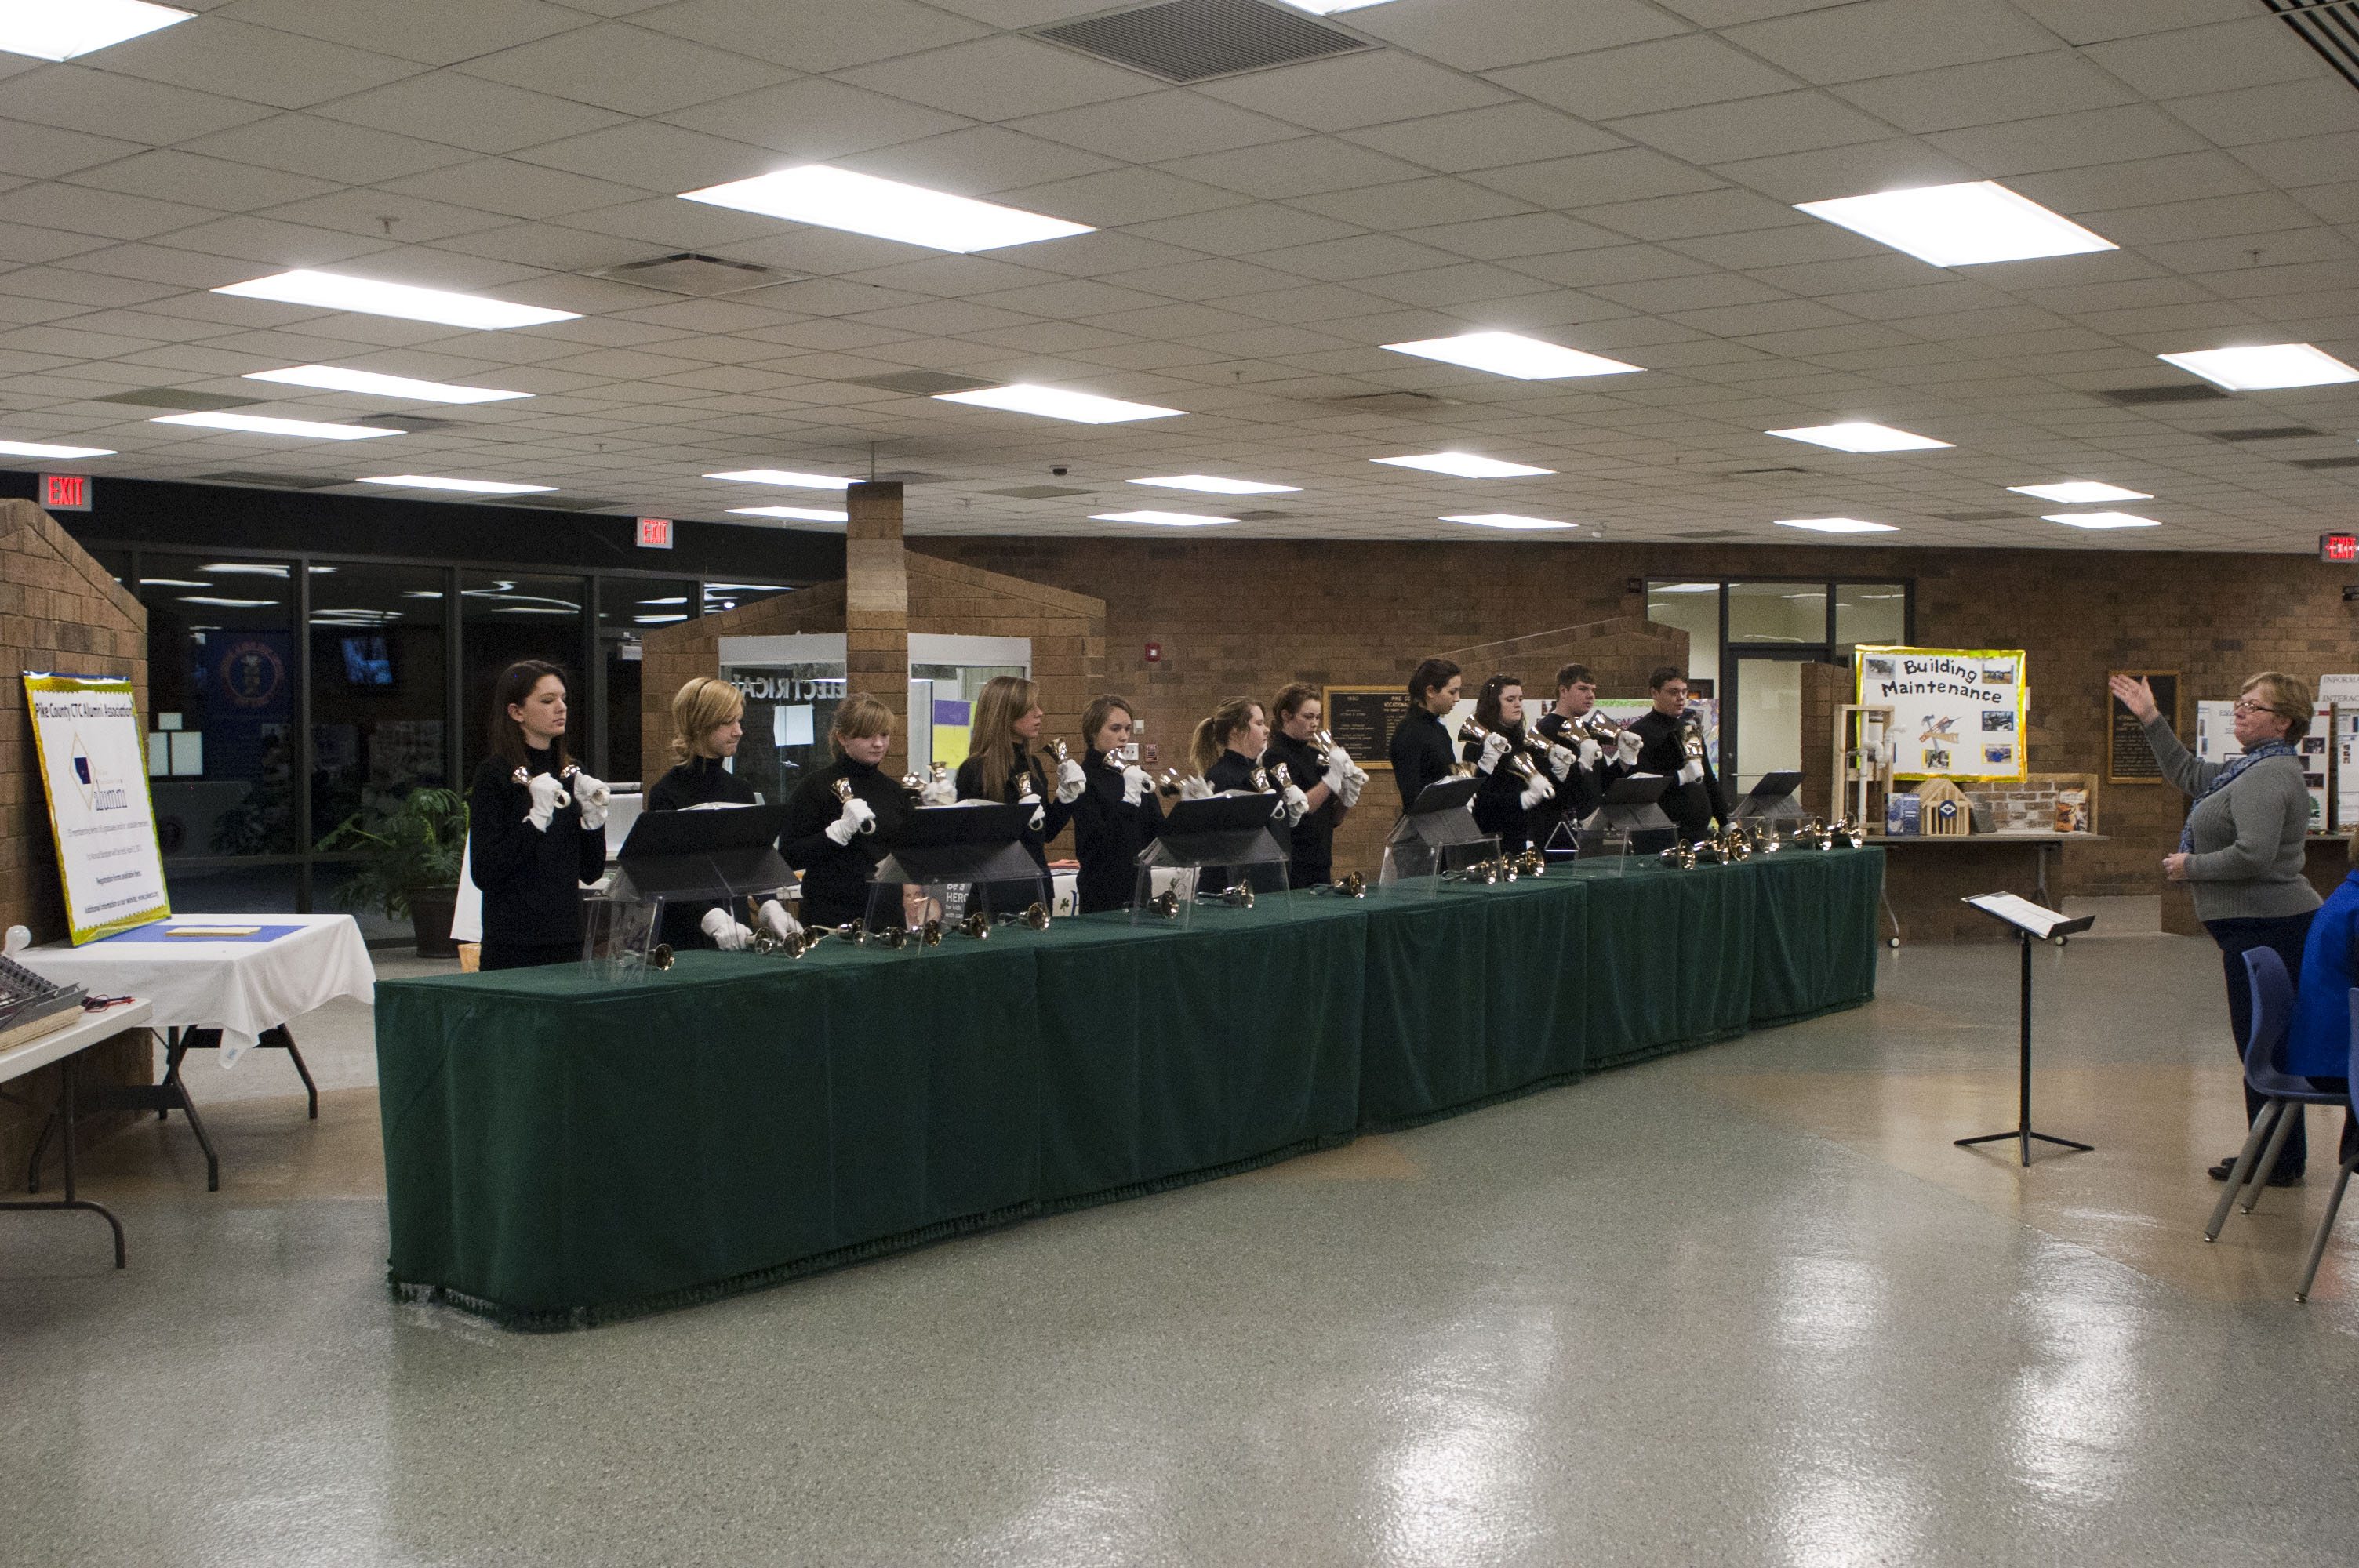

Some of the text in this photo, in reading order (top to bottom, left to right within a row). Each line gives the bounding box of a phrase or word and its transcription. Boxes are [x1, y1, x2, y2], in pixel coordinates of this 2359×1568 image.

[49, 476, 84, 506] EXIT
[644, 519, 668, 544] EXIT
[2329, 536, 2356, 558] EXIT
[1903, 658, 1978, 684] Building
[1881, 680, 2002, 703] Maintenance
[35, 702, 133, 721] Pike County CTC Alumni Association
[93, 779, 128, 811] alumni
